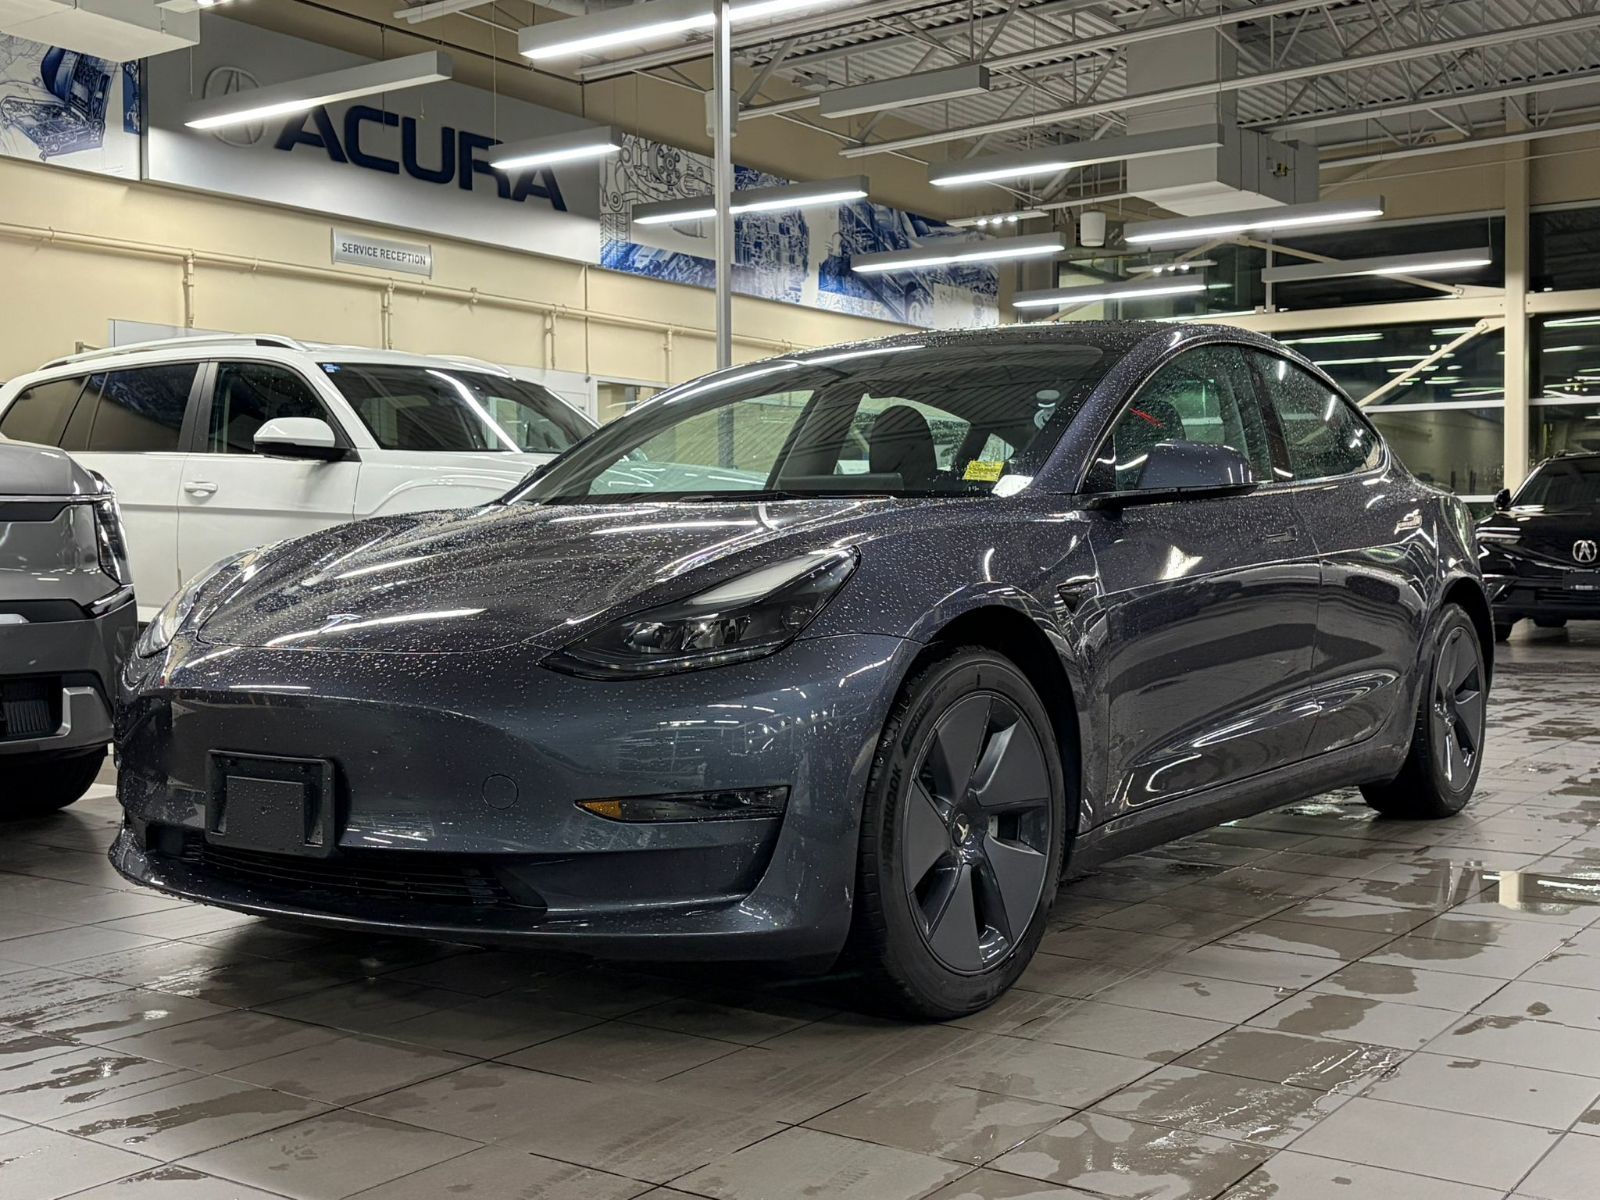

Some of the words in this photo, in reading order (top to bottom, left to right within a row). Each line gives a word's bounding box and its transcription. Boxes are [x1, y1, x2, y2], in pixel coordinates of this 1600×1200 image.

[274, 104, 568, 212] ACURA
[342, 242, 378, 258] SERVICE
[380, 248, 426, 266] RECEPTION
